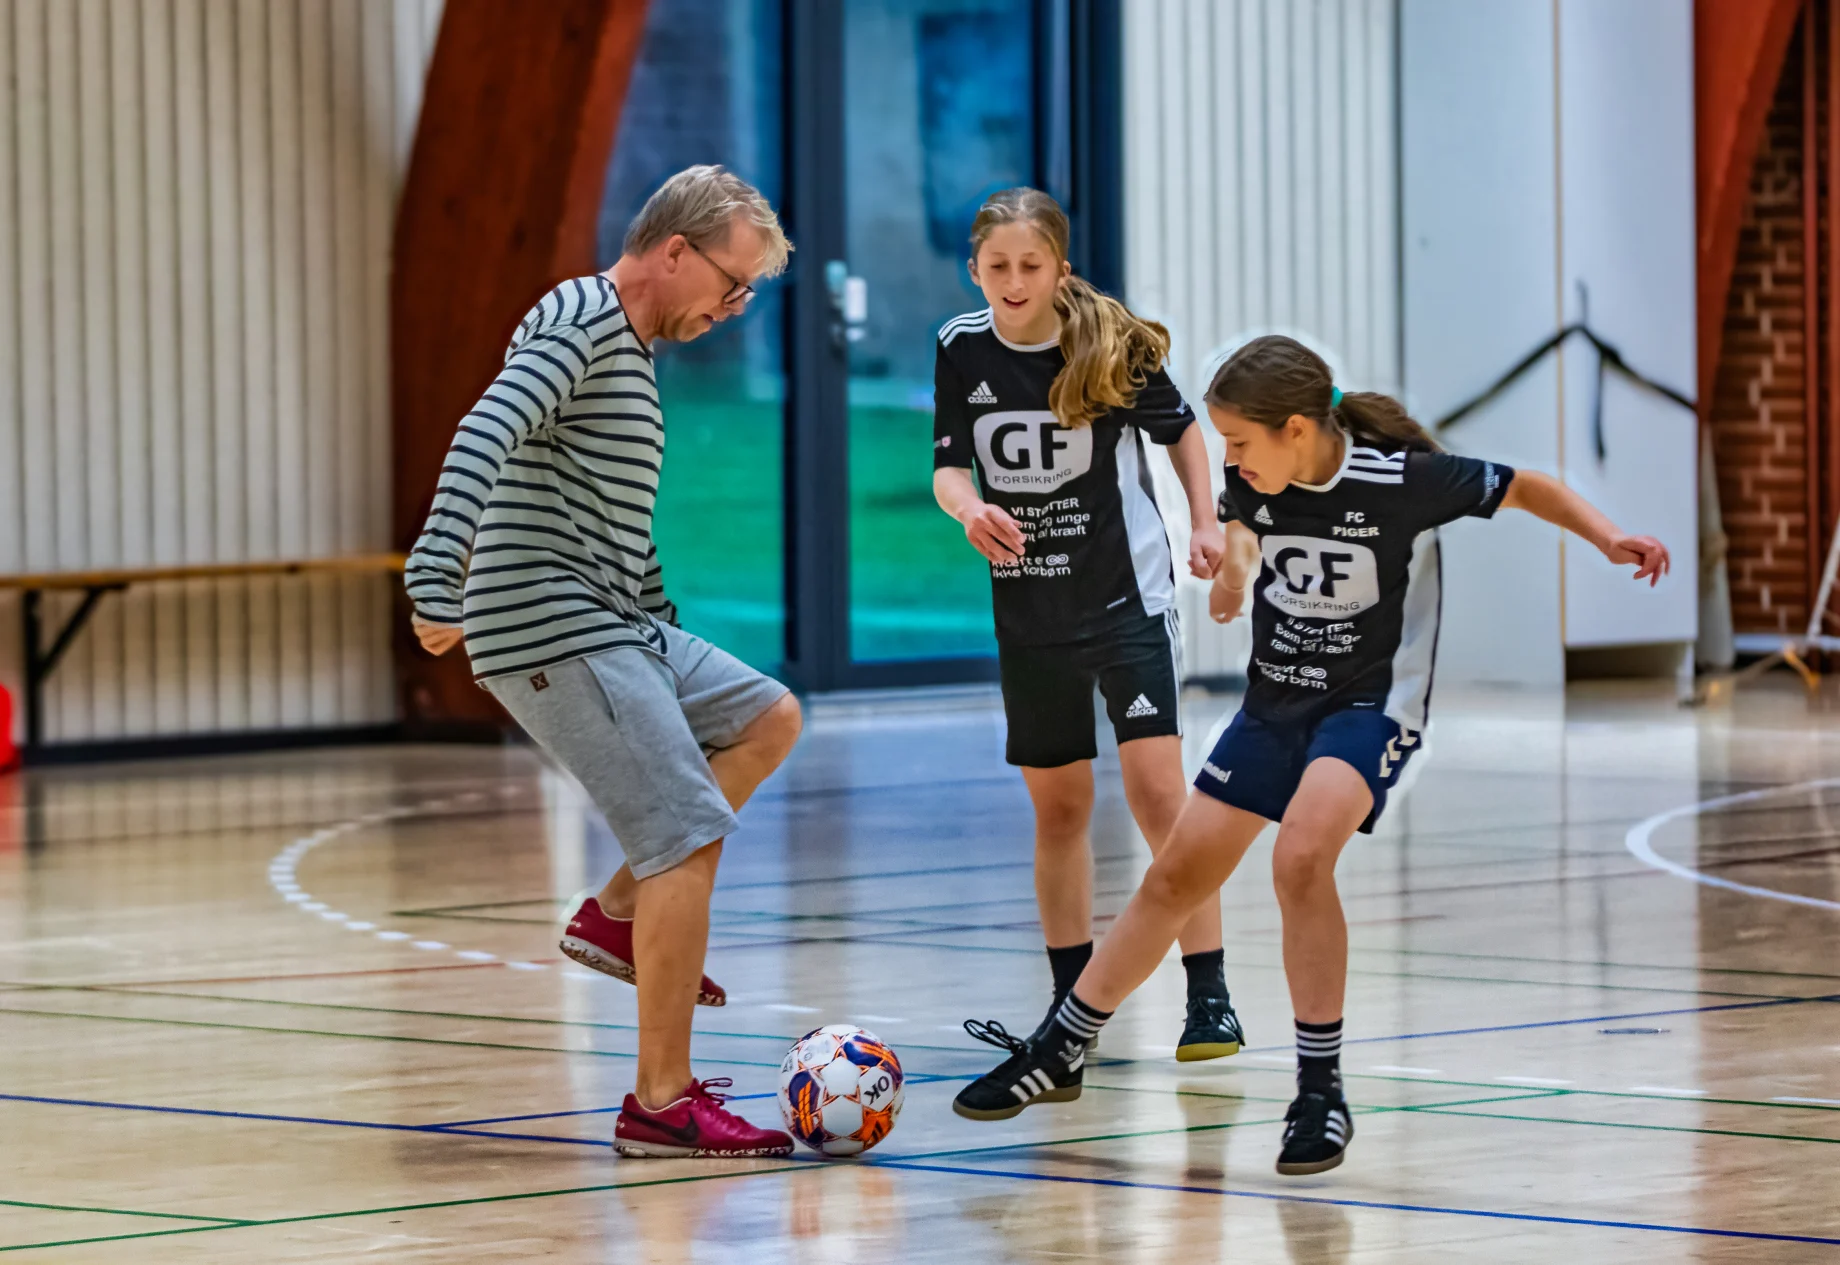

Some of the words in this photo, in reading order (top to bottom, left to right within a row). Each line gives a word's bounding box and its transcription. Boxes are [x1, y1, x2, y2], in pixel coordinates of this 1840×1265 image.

[968, 396, 998, 404] adidas
[990, 422, 1072, 470] GF
[994, 468, 1072, 485] FORSIKRING
[1011, 507, 1024, 516] VI
[1345, 511, 1365, 523] FC
[1056, 513, 1090, 524] unge
[1050, 525, 1086, 537] kræft
[1332, 526, 1380, 537] PIGER
[1040, 566, 1071, 577] børn
[1274, 547, 1353, 597] GF
[1273, 591, 1360, 611] FORSIKRING
[1275, 623, 1301, 644] Børn
[1270, 638, 1298, 654] ramt
[1289, 675, 1328, 690] børn
[1126, 706, 1158, 718] adidas
[864, 1075, 890, 1105] OK
